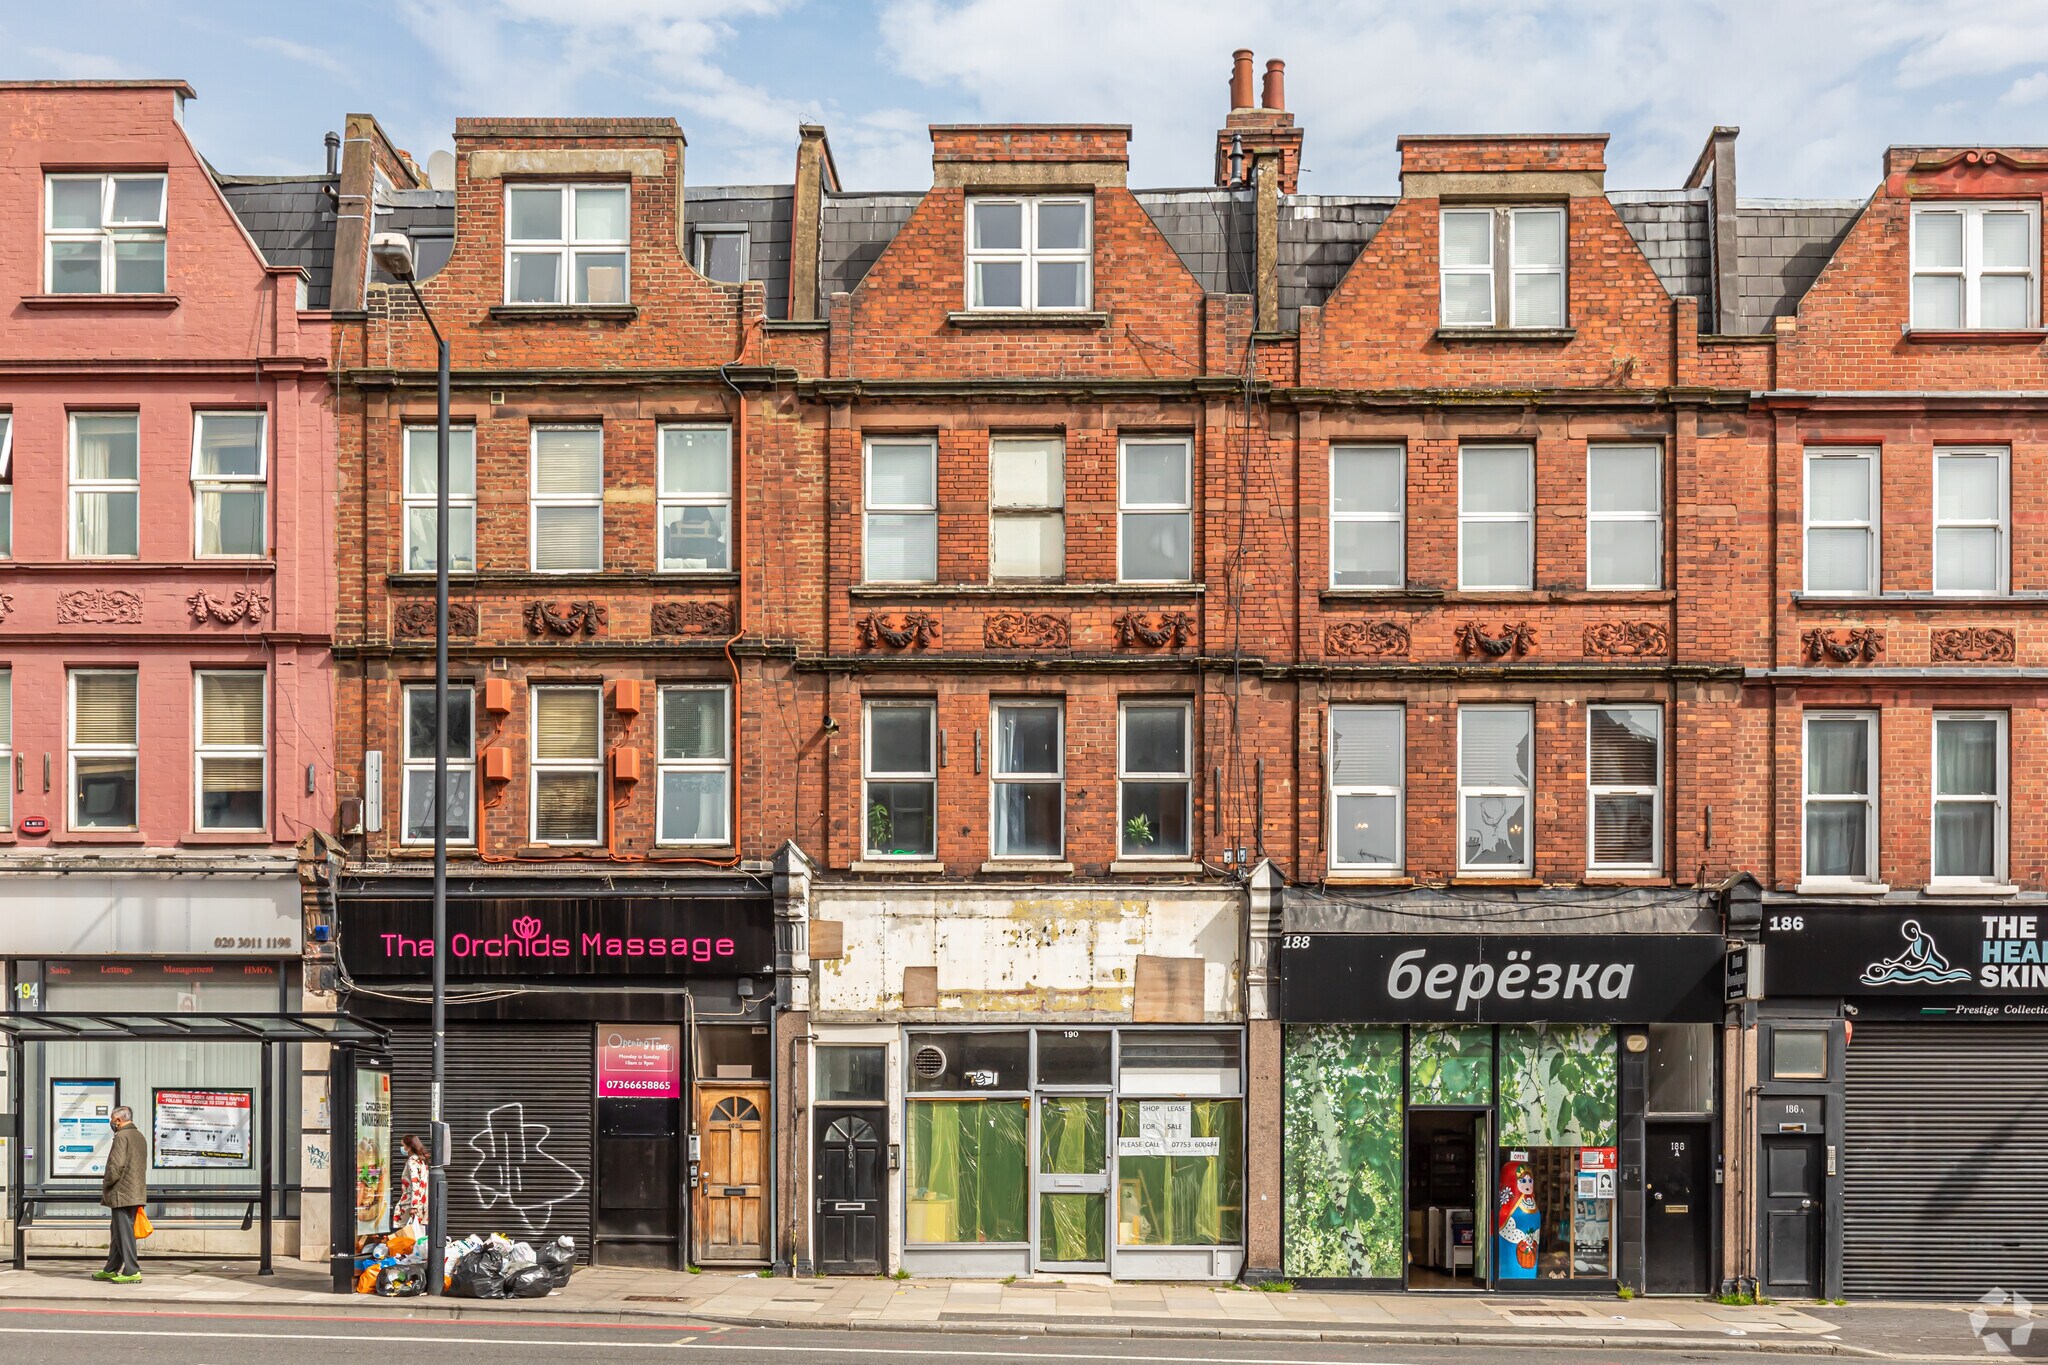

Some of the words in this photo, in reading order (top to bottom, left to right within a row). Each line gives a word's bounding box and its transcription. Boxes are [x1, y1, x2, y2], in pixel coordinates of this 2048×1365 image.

[1769, 916, 1804, 932] 186
[1981, 915, 2038, 939] THE
[214, 937, 235, 949] 020
[238, 937, 263, 949] 3011
[266, 937, 292, 949] 1198
[381, 933, 435, 957] Tha
[452, 932, 570, 957] Orchids
[583, 933, 735, 962] Massage
[1282, 935, 1311, 949] 188
[50, 966, 71, 975] Sales
[101, 965, 133, 975] Lettings
[163, 965, 214, 975] Management
[244, 966, 273, 975] HMO's
[1387, 948, 1635, 1011] берёзка
[14, 983, 39, 999] 194
[1956, 1004, 1999, 1016] Prestige
[608, 1033, 650, 1050] Opening
[645, 1037, 672, 1051] Time
[606, 1080, 671, 1090] 07366658865
[1785, 1104, 1799, 1114] 186
[1671, 1142, 1685, 1151] 188
